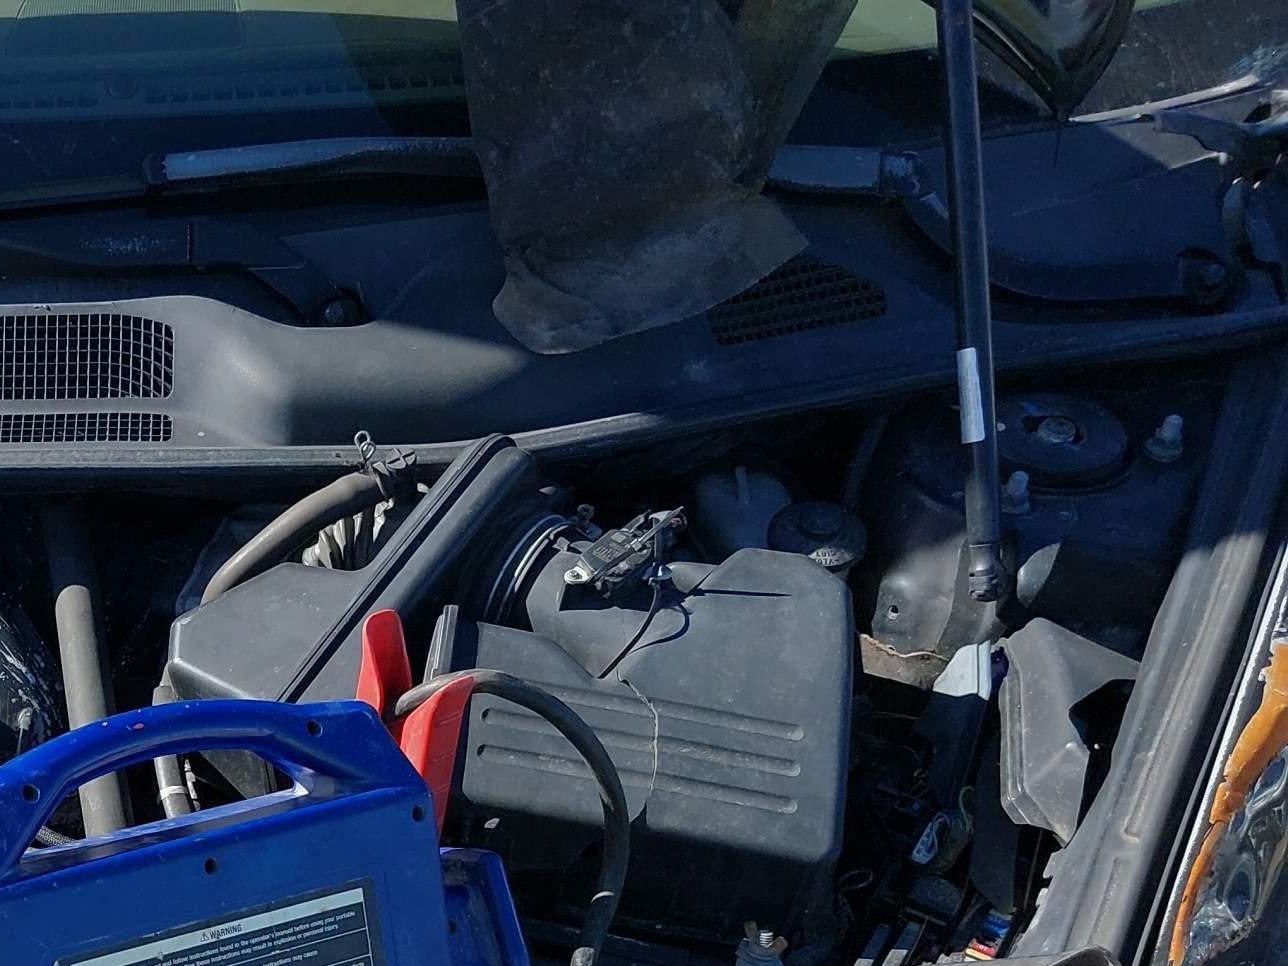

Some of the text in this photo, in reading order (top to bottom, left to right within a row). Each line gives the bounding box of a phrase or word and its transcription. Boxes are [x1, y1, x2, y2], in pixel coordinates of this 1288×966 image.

[209, 922, 241, 939] WARNING
[188, 947, 218, 961] instructions
[210, 949, 240, 963] instructions
